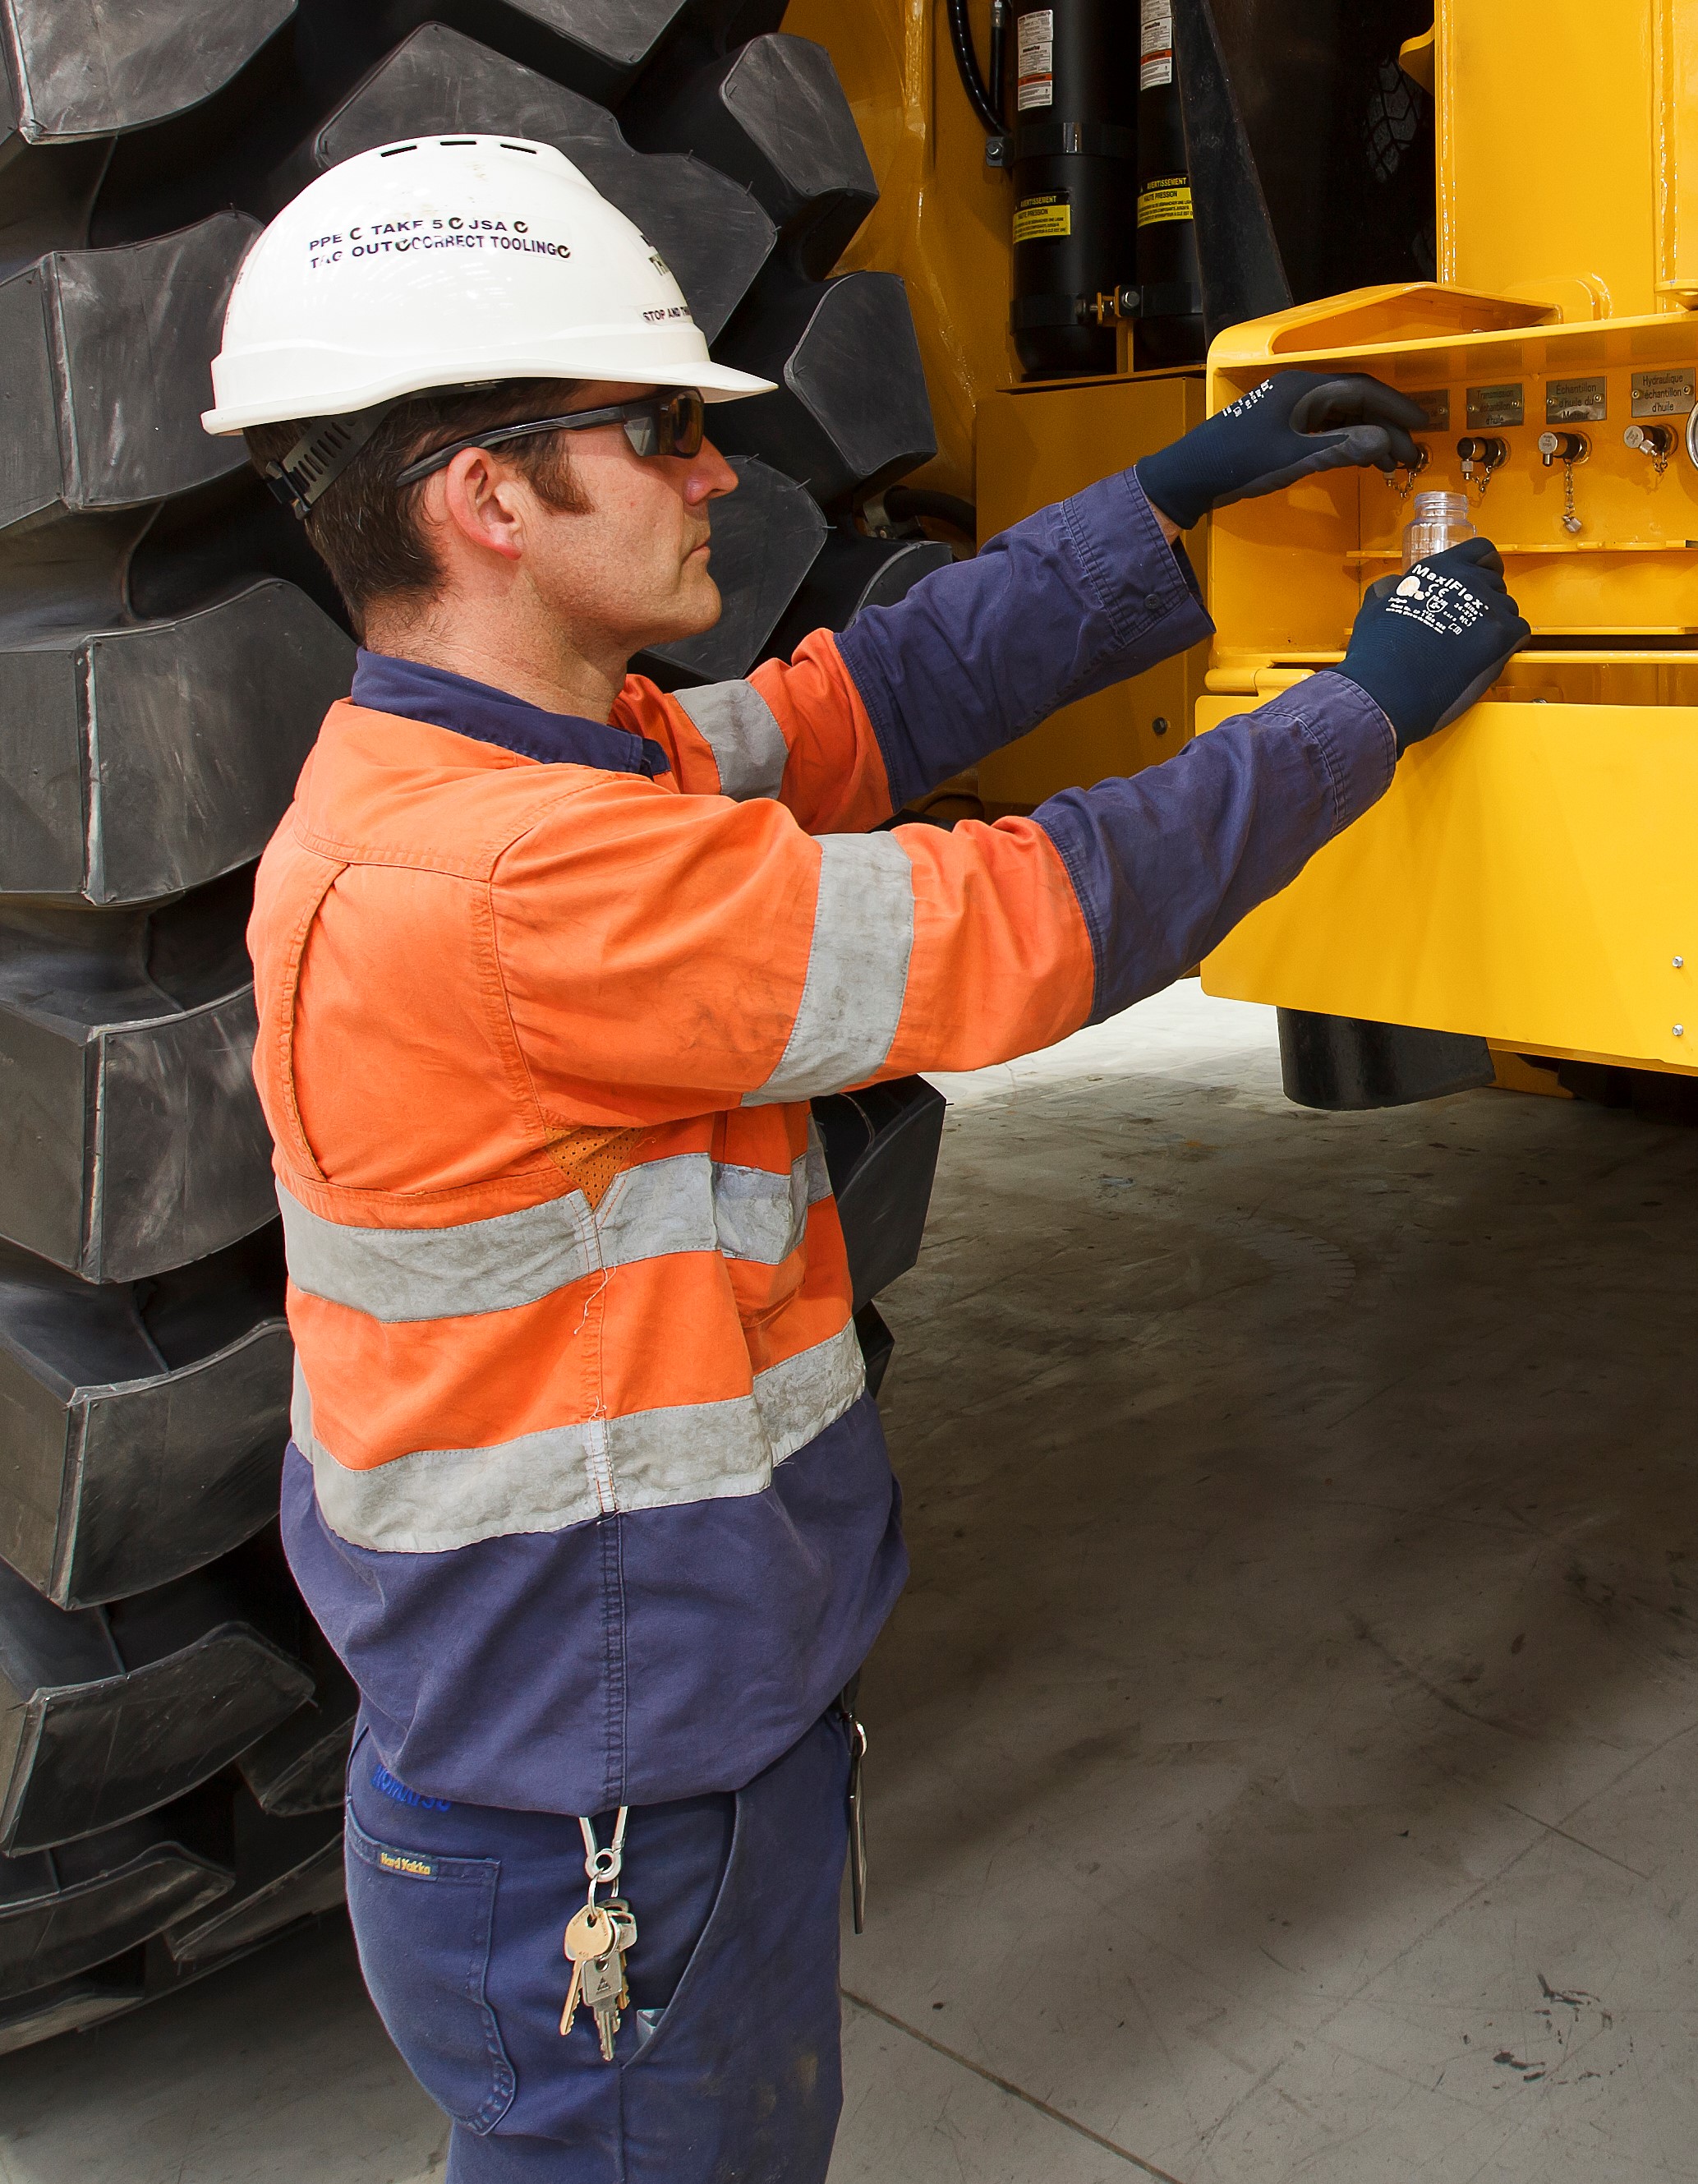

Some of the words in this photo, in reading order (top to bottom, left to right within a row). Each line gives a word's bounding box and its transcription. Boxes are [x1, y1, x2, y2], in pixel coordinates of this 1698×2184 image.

[309, 233, 343, 251] PPE
[432, 219, 444, 230] 5
[468, 219, 508, 231] JSA
[351, 241, 393, 257] OUT
[490, 235, 557, 256] TOOLING
[642, 309, 665, 321] STOP
[1642, 373, 1683, 387] Hydraulique
[1584, 395, 1594, 407] du
[1651, 401, 1674, 412] d'huile
[1411, 564, 1484, 609] MaxiFlex
